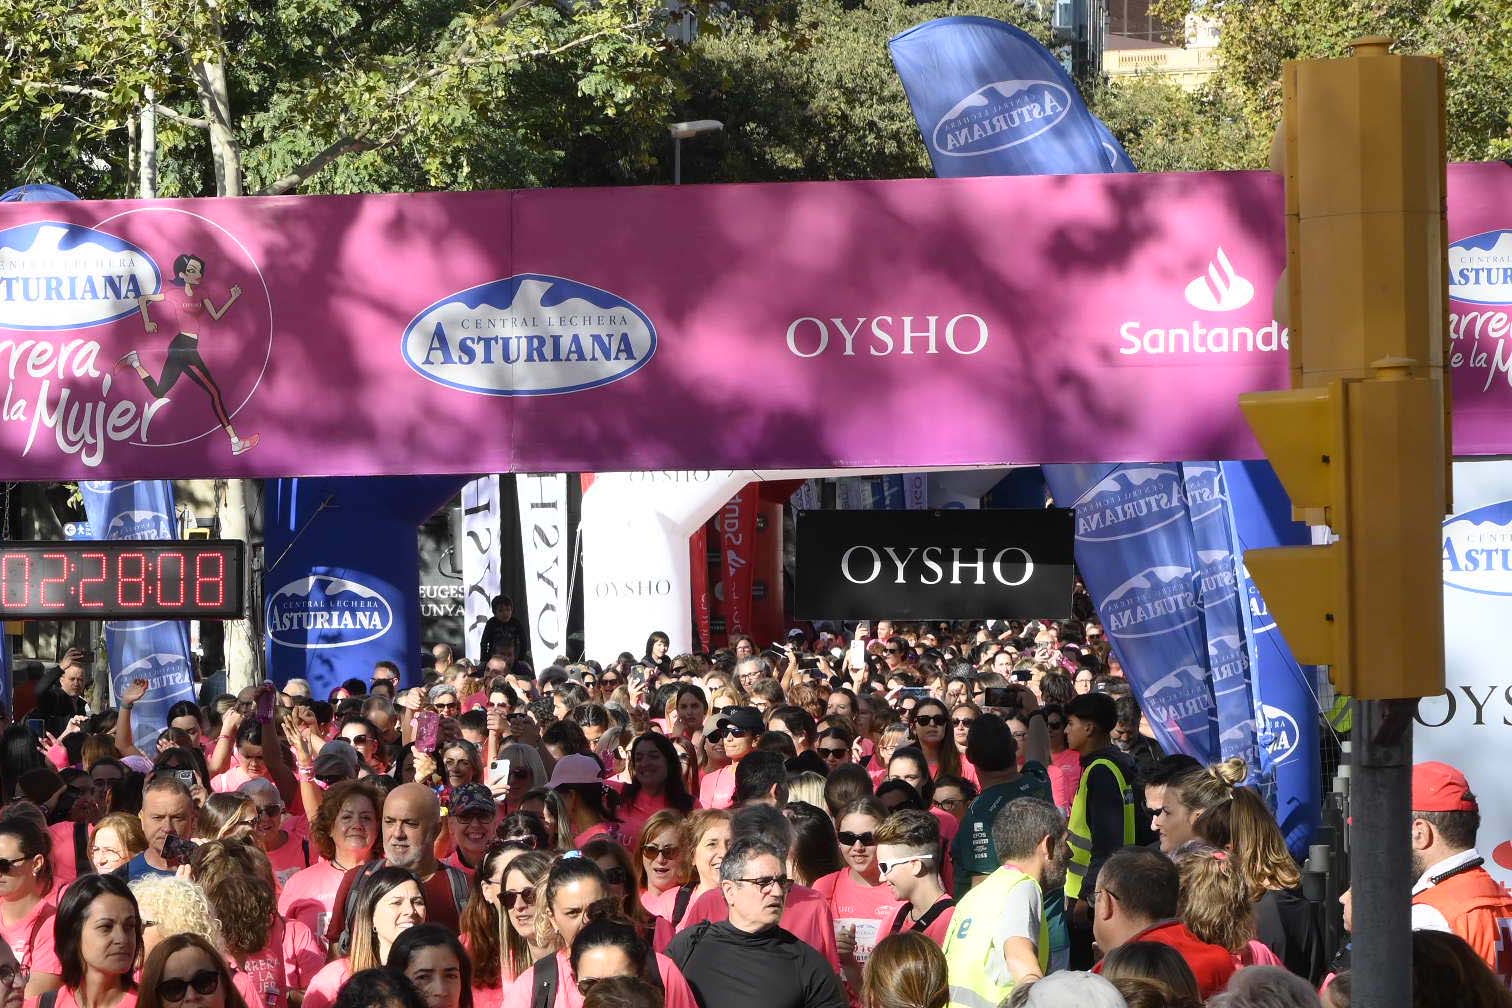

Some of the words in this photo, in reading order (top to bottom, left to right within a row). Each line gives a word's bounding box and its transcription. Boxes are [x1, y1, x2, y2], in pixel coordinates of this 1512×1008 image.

[460, 317, 540, 329] CENTRAL
[546, 314, 630, 327] LECHERA
[786, 313, 989, 357] OYSHO
[421, 320, 636, 366] ASTURIANA
[1, 384, 30, 421] la
[21, 373, 171, 466] Mujer
[1, 553, 224, 606] 02:28:08
[841, 546, 1034, 586] OYSHO
[595, 580, 671, 598] OYSHO
[270, 606, 384, 632] ASTURIANA
[421, 604, 466, 617] UNYA
